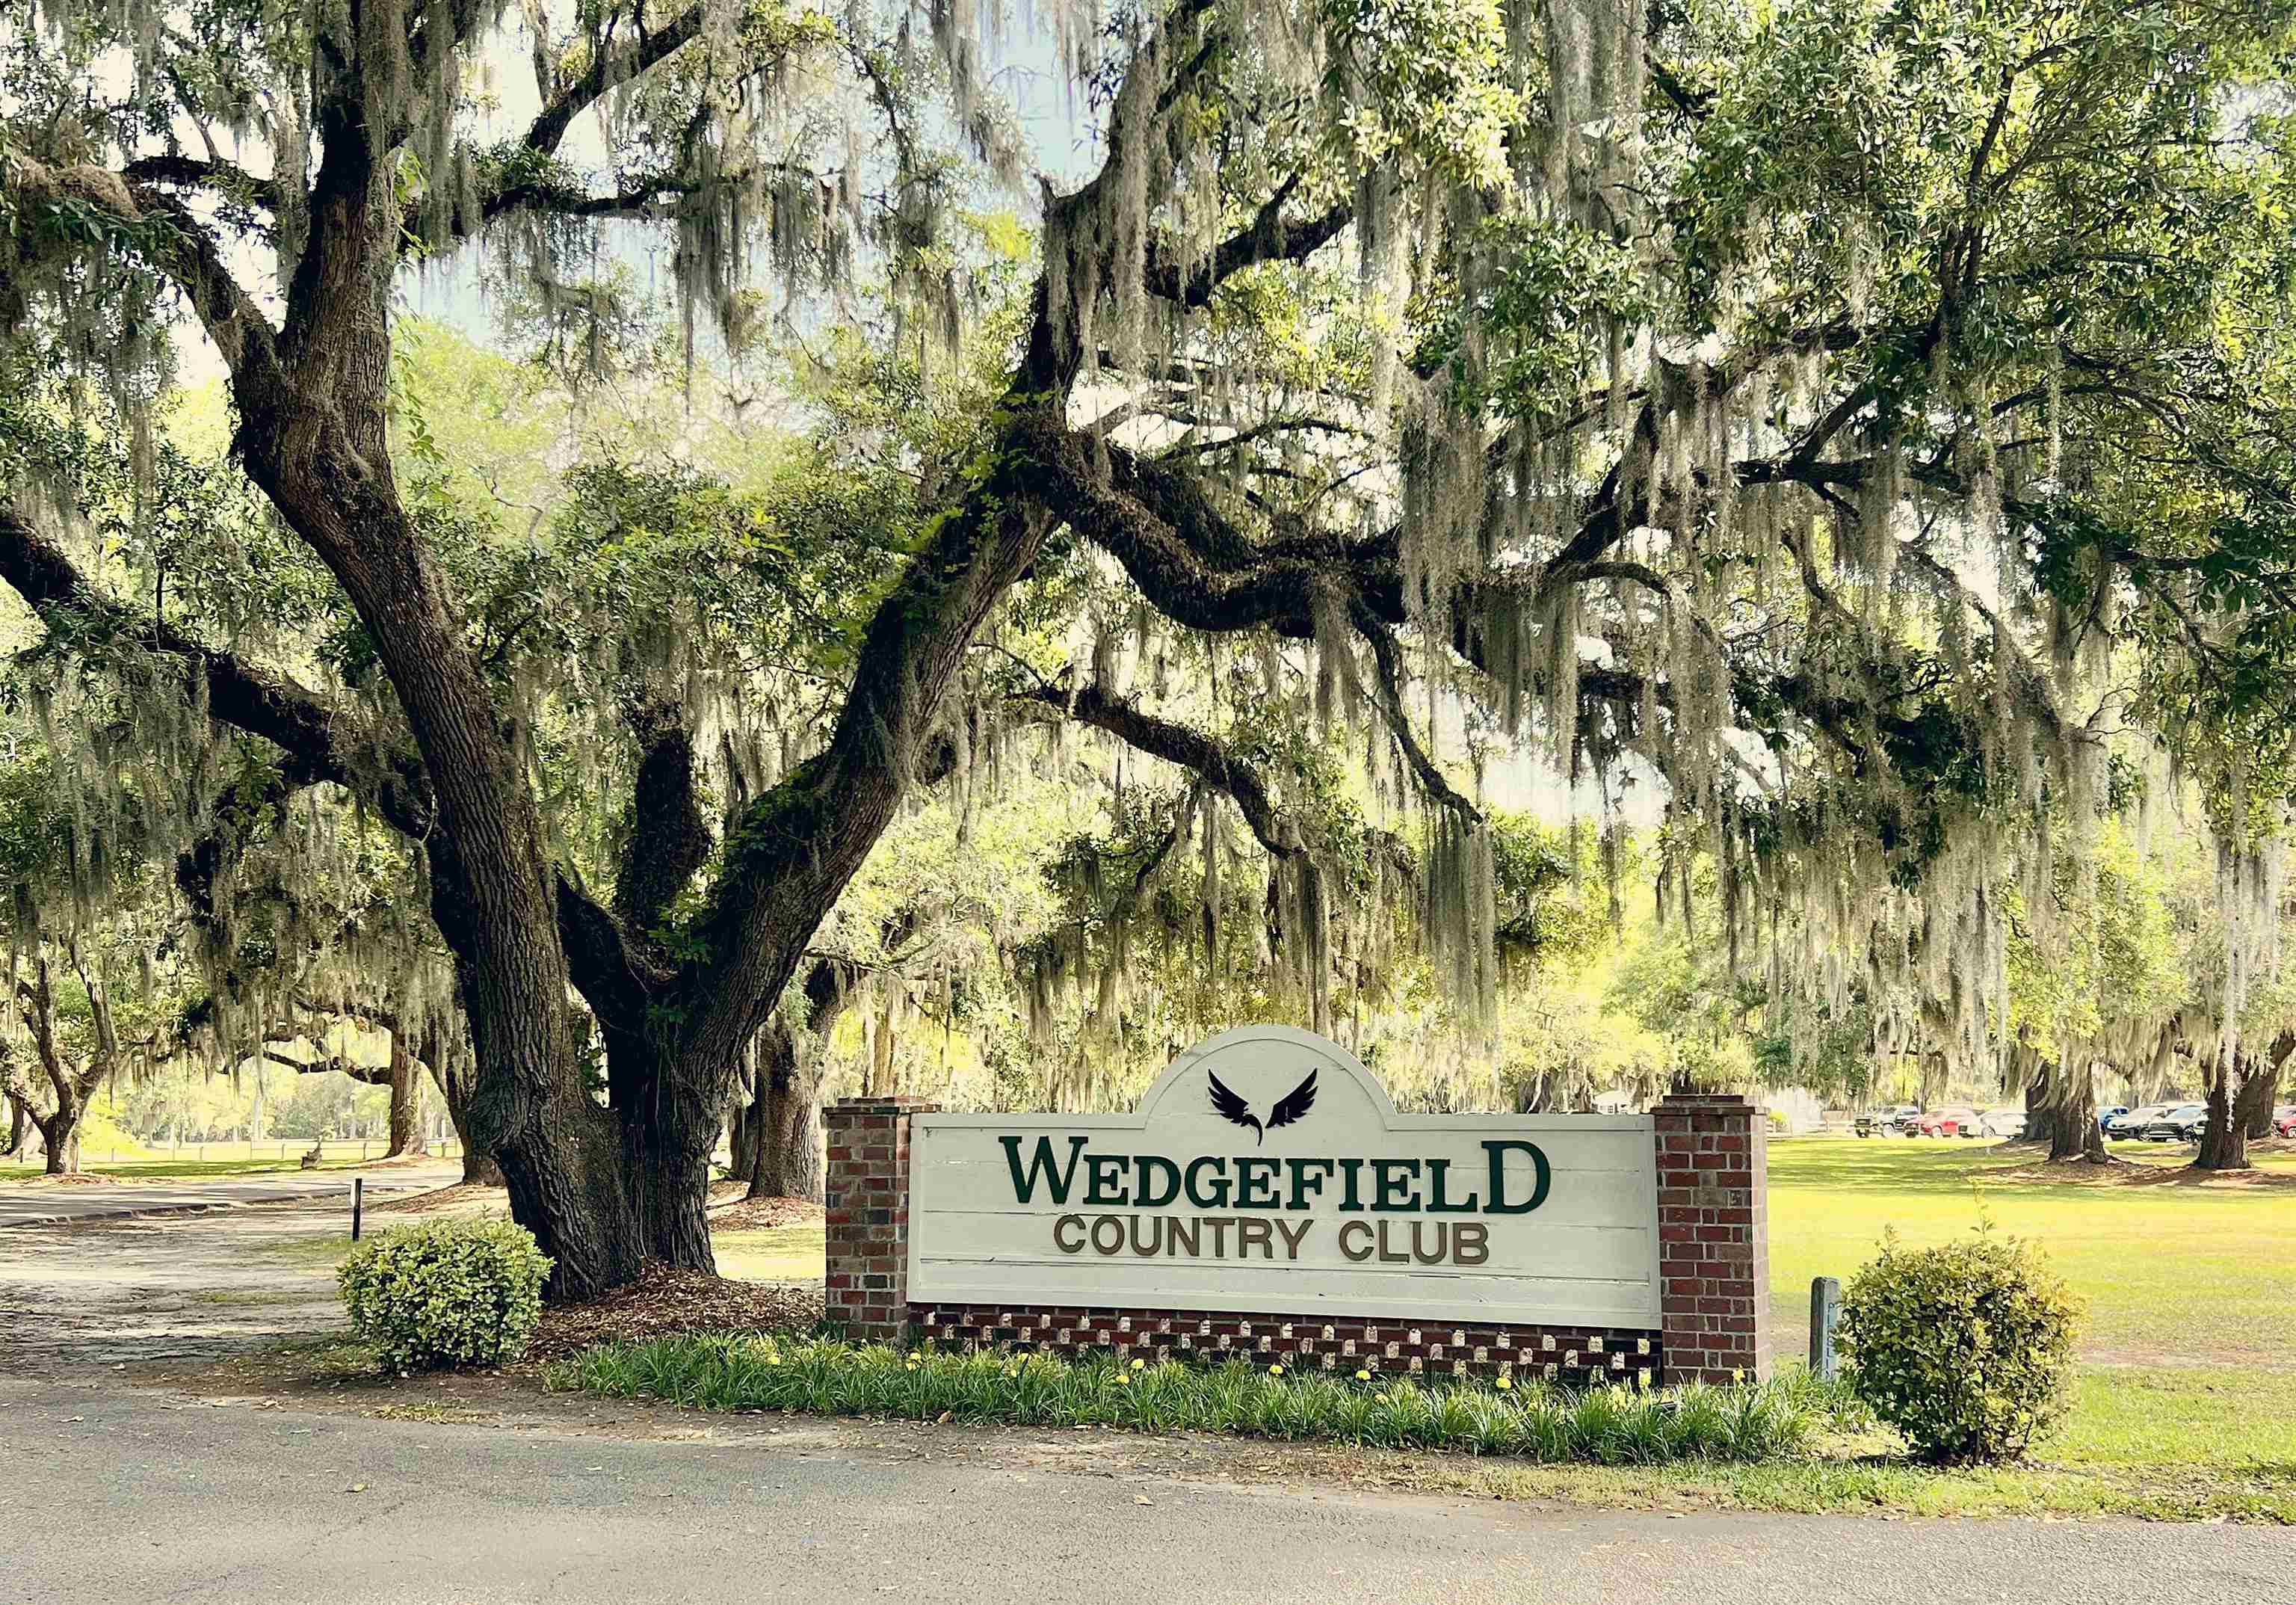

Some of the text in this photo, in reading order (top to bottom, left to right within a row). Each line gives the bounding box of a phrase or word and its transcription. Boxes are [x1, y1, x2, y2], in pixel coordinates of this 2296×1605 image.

[999, 1136, 1551, 1214] WEDGEFIELD
[1054, 1214, 1490, 1264] COUNTRY CLUB
